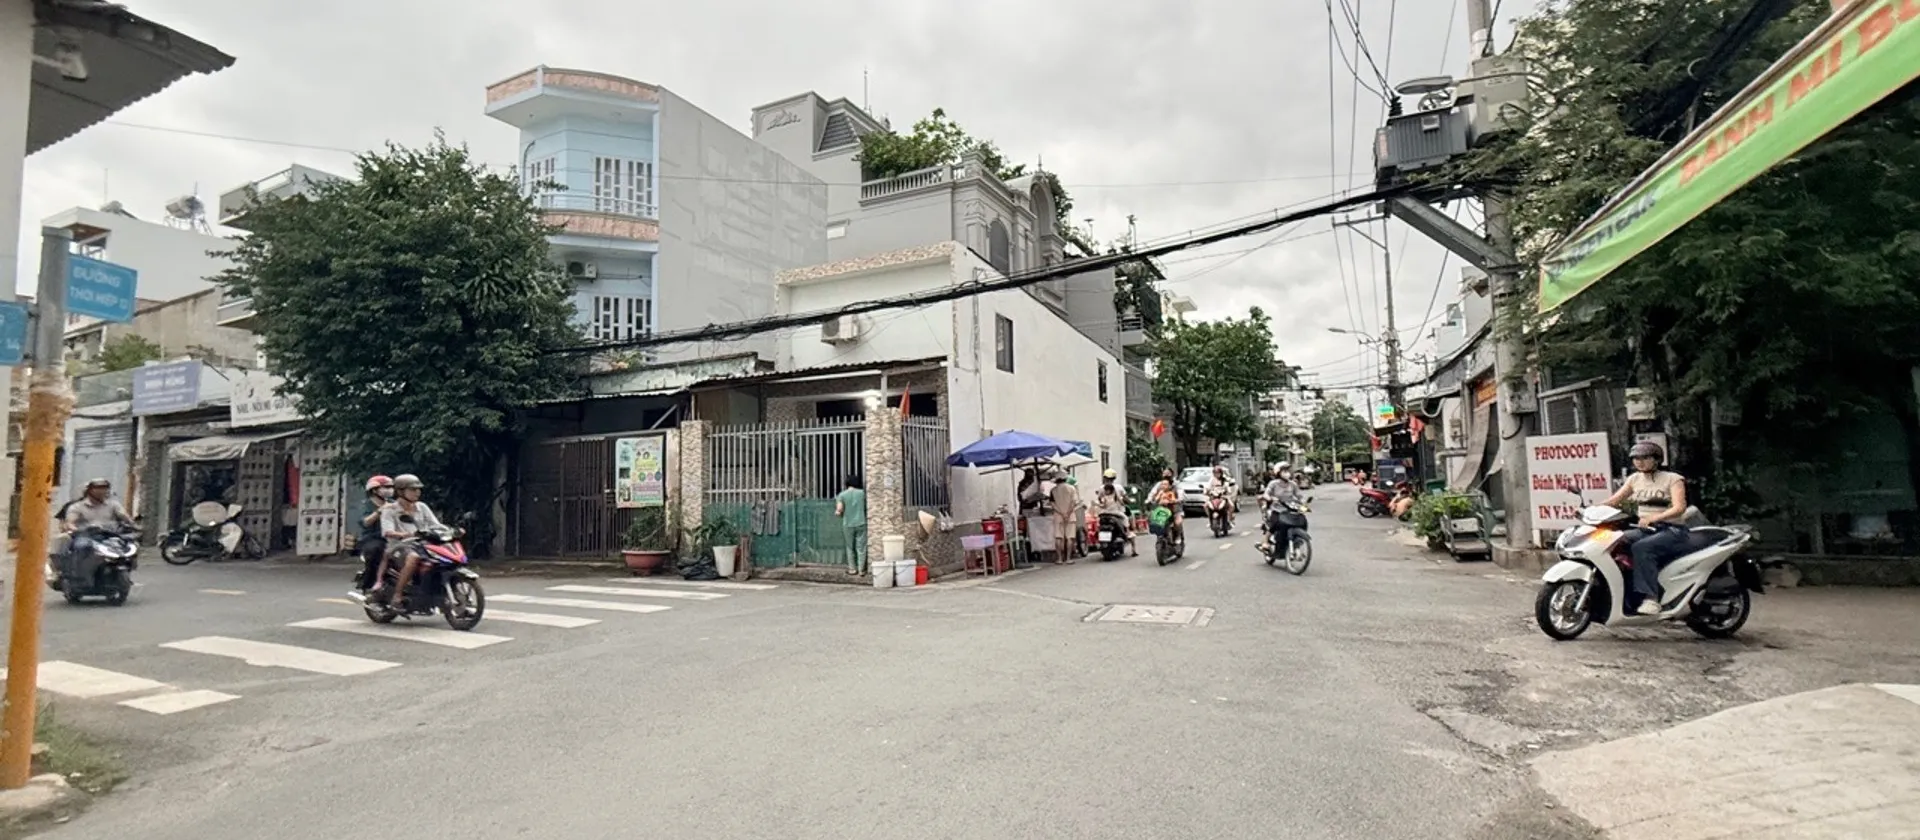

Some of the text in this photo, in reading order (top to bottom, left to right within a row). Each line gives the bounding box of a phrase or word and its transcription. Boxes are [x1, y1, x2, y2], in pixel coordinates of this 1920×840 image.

[1534, 443, 1598, 460] PHOTOCOPY
[1532, 473, 1554, 490] Đánh
[1539, 505, 1551, 519] IN
